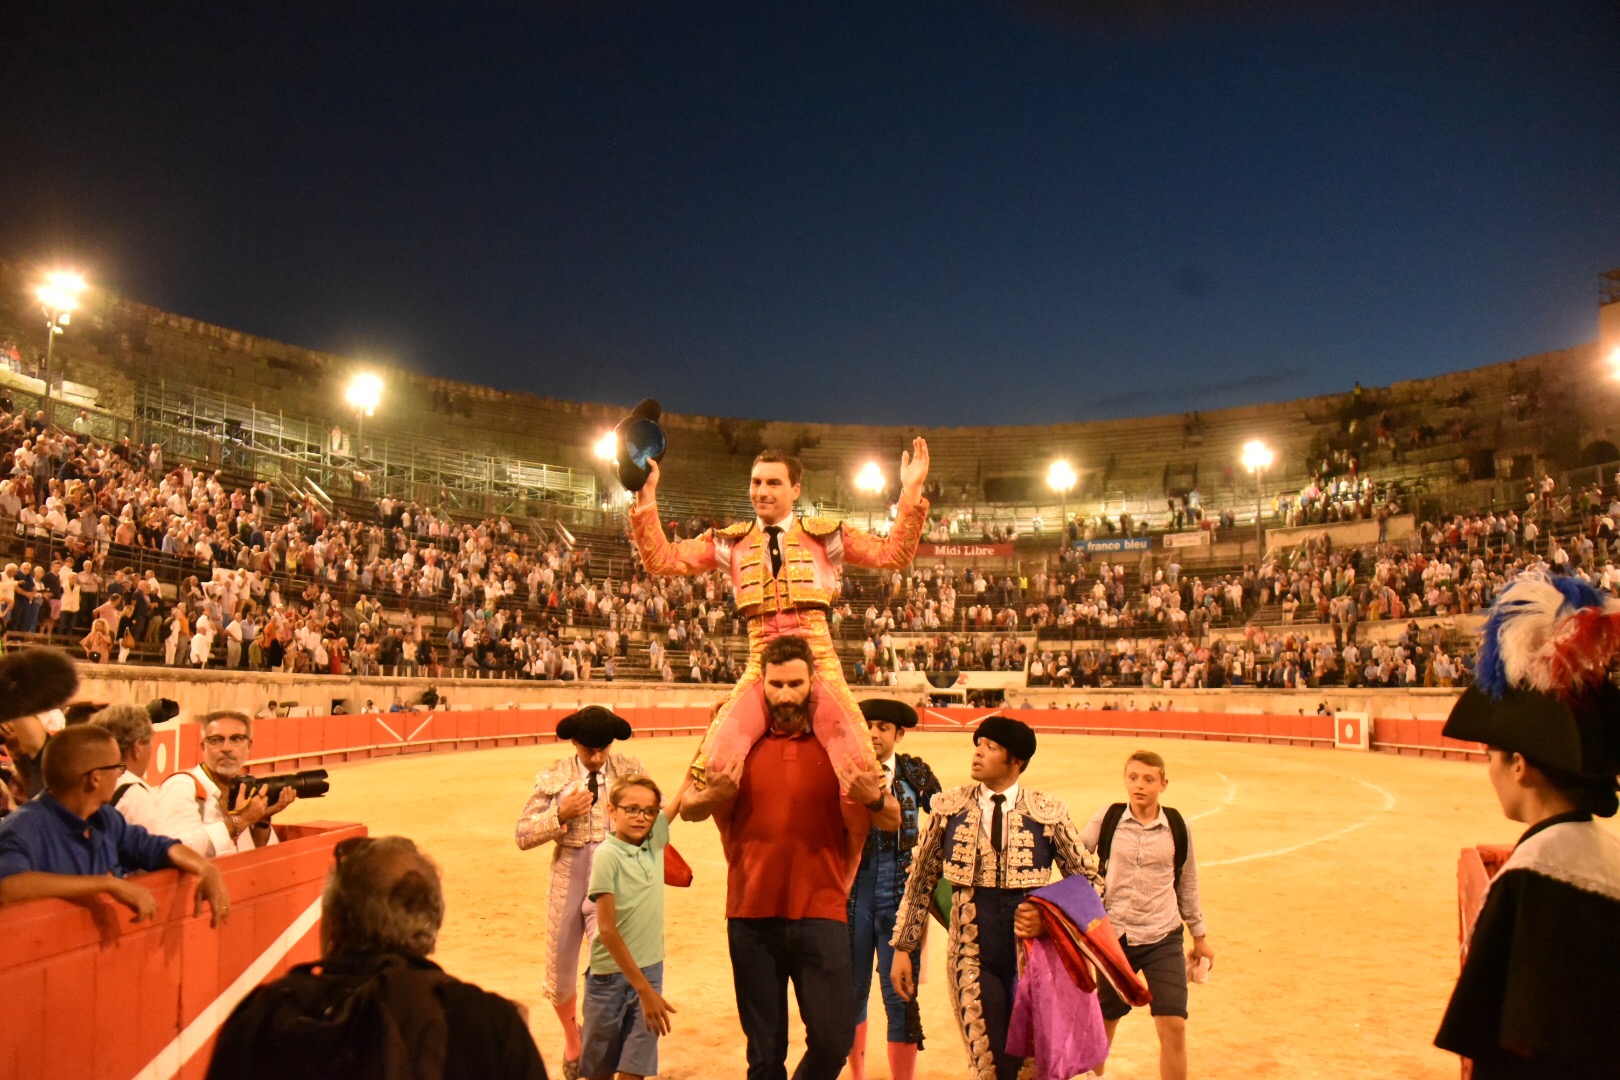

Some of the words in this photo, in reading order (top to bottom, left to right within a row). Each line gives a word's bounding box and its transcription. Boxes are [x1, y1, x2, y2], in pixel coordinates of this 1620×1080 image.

[934, 545, 961, 555] Midi
[963, 545, 995, 556] Libre
[1087, 541, 1121, 551] france
[1124, 539, 1148, 549] bleu
